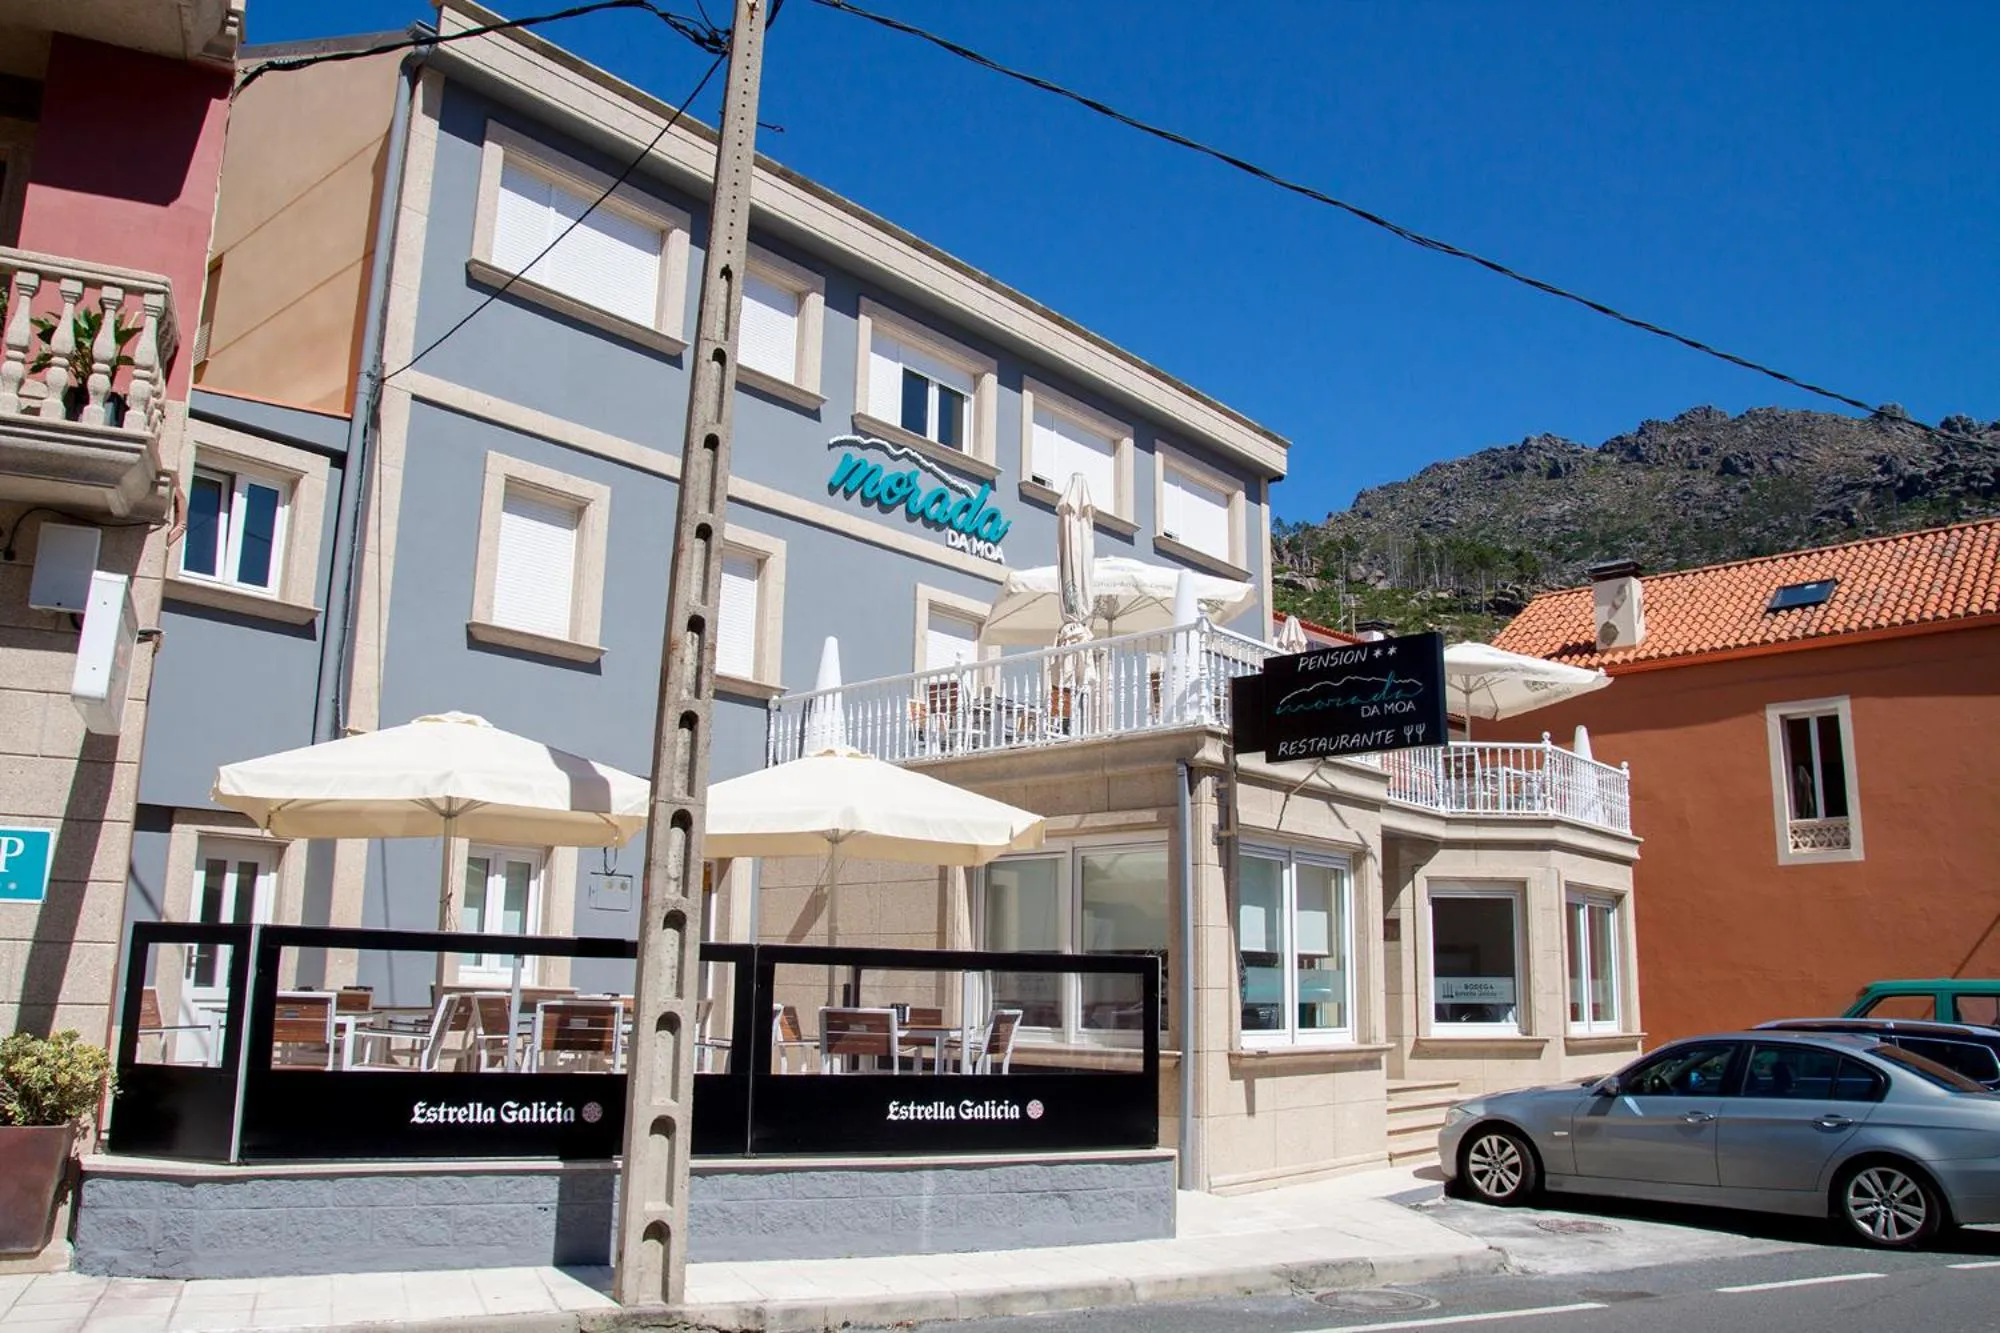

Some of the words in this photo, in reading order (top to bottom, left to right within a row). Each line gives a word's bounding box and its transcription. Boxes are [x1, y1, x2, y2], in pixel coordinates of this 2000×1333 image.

[829, 452, 1012, 542] morada
[946, 530, 969, 551] DA
[971, 539, 1005, 562] MOA
[1298, 648, 1368, 672] PENSION
[1276, 671, 1424, 716] morada
[1361, 705, 1380, 718] DA
[1384, 700, 1416, 715] MOA
[1278, 729, 1396, 756] RESTAURANTE
[410, 1101, 496, 1124] Estrella
[500, 1101, 576, 1124] Galicia
[886, 1100, 956, 1120] Estrella
[959, 1099, 1020, 1120] Galicia
